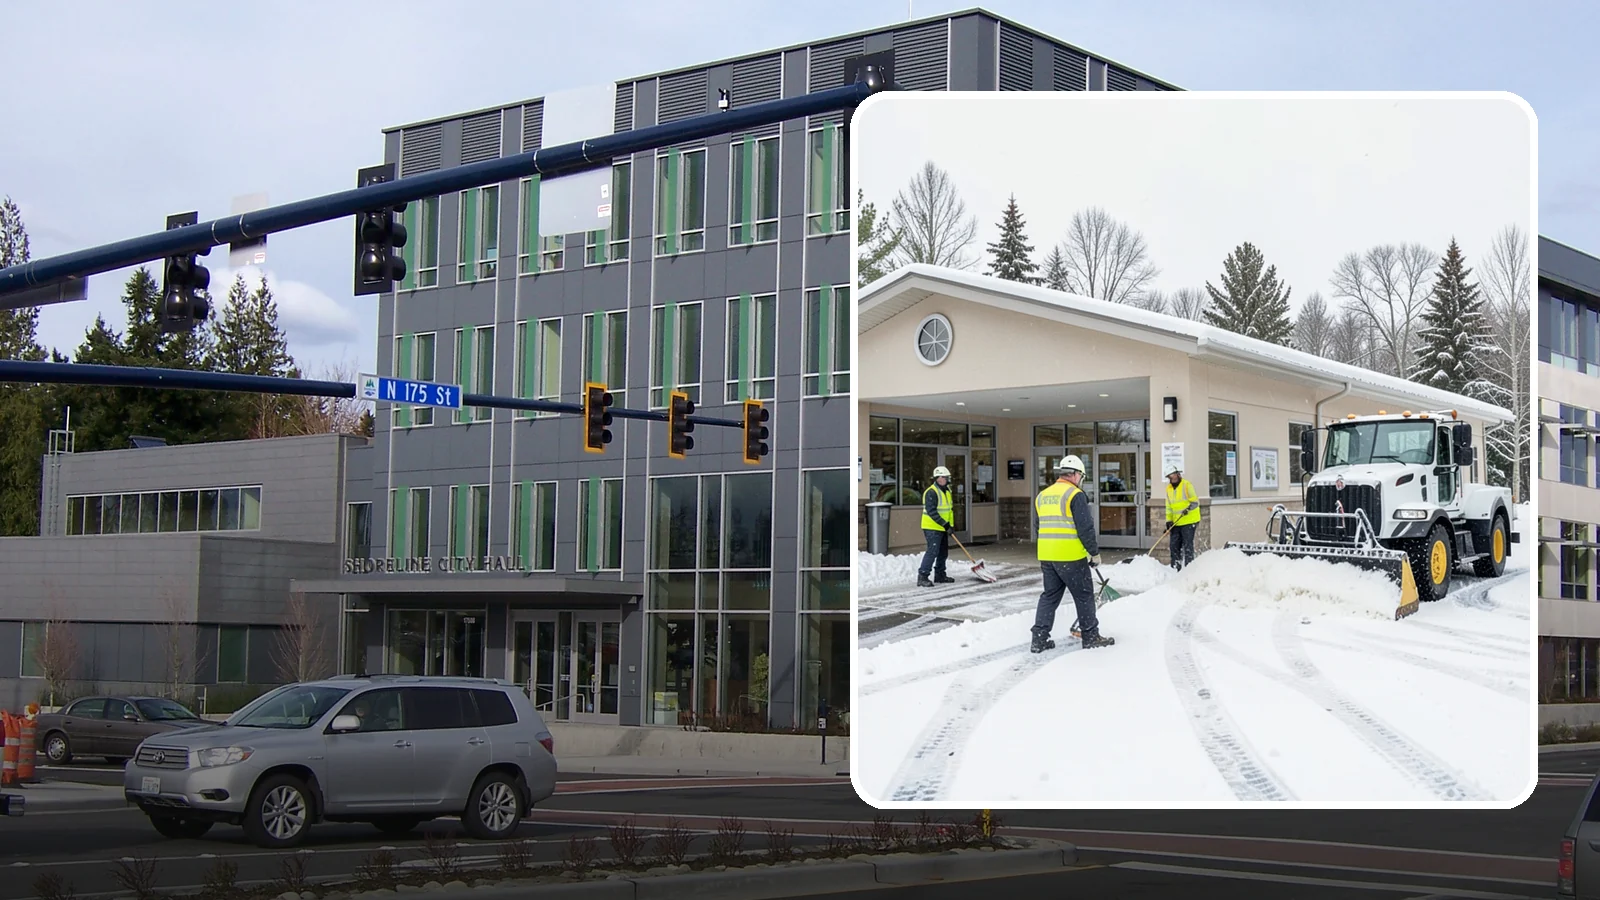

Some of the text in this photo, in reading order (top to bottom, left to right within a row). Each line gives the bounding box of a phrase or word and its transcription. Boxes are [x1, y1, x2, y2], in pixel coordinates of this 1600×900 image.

[387, 380, 451, 406] N 175 St
[343, 556, 525, 574] SHORELINE CITY HALL
